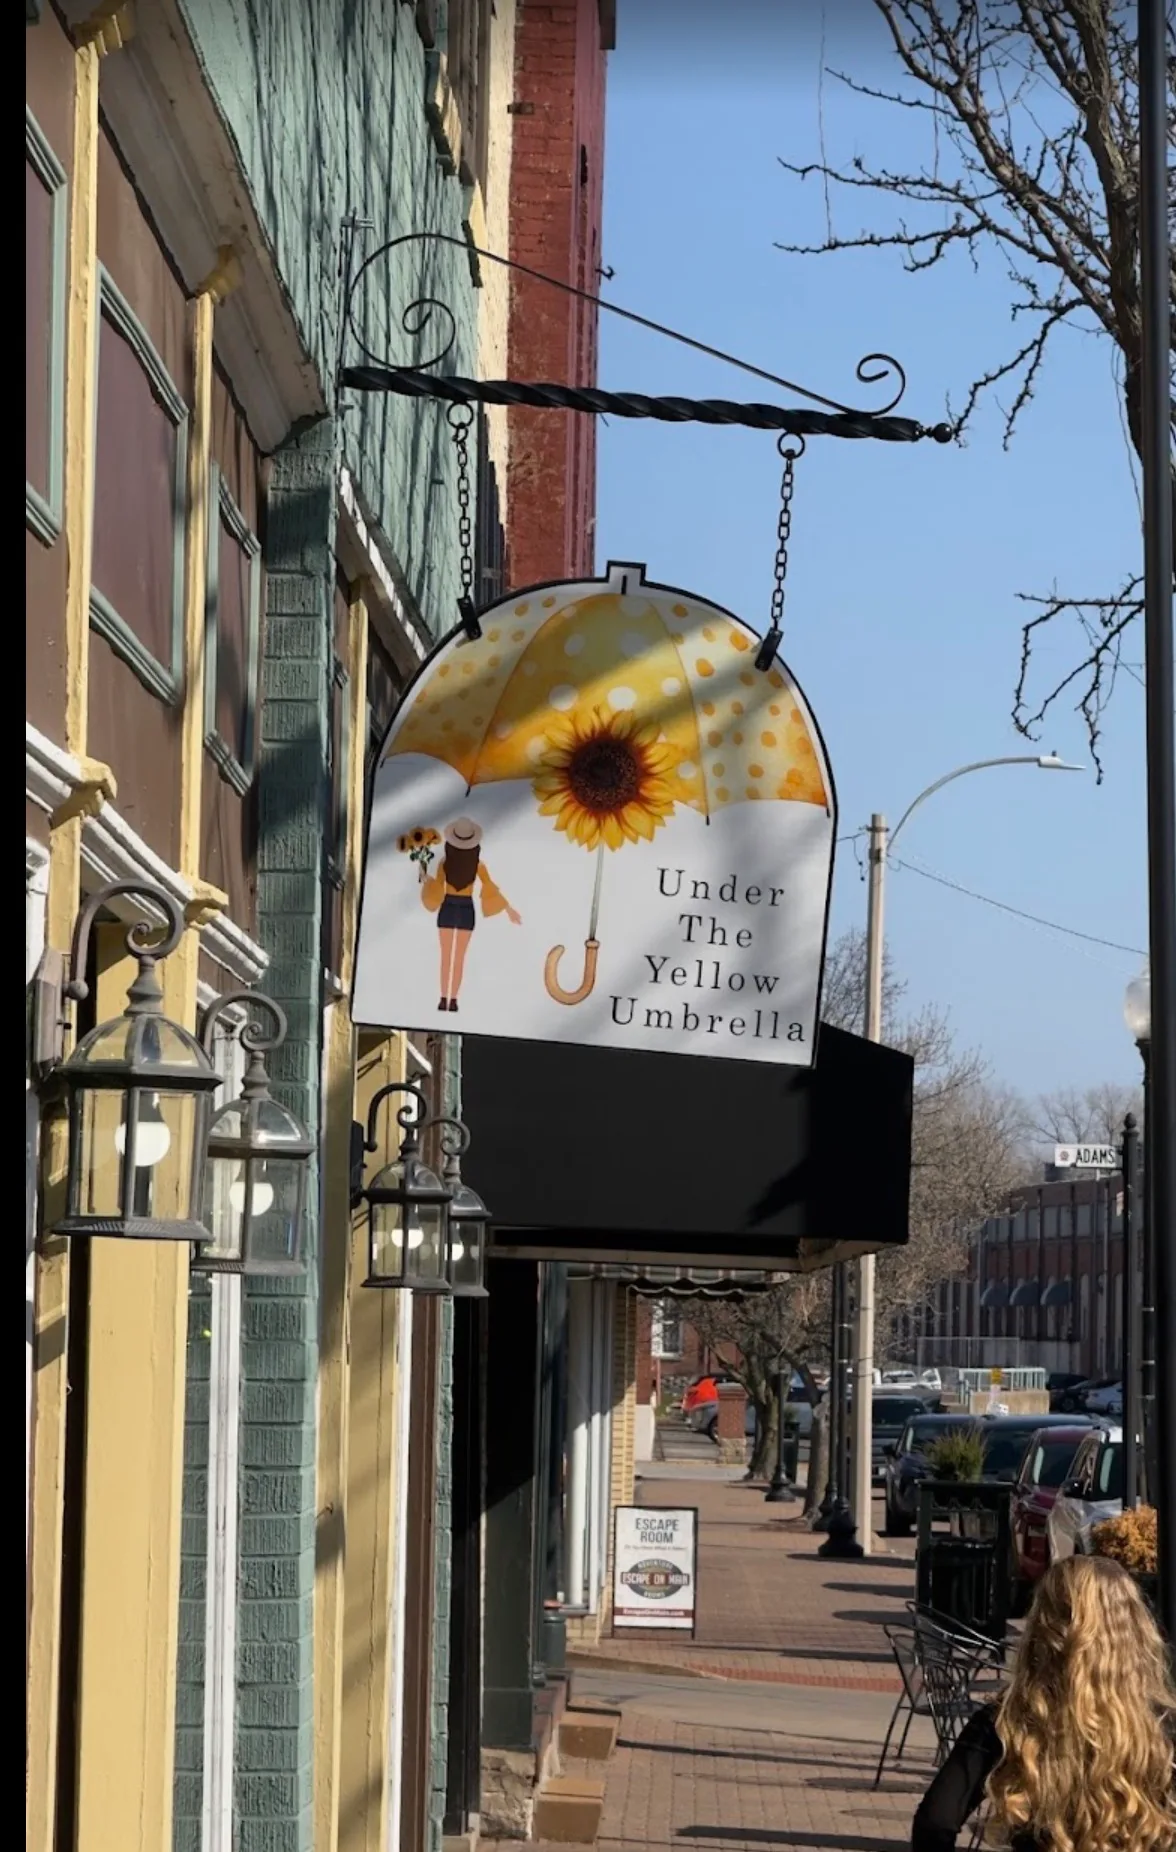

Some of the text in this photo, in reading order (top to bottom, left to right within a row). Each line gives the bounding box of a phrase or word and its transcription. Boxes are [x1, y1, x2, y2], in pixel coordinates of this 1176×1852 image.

[657, 867, 784, 907] Under
[678, 914, 753, 948] The
[643, 954, 781, 995] Yellow
[609, 995, 806, 1042] Umbrella
[1075, 1147, 1116, 1164] ADAMS
[635, 1517, 680, 1531] ESCAPE
[640, 1530, 674, 1543] ROOM
[622, 1572, 651, 1584] ESCAPE
[653, 1573, 666, 1585] ON
